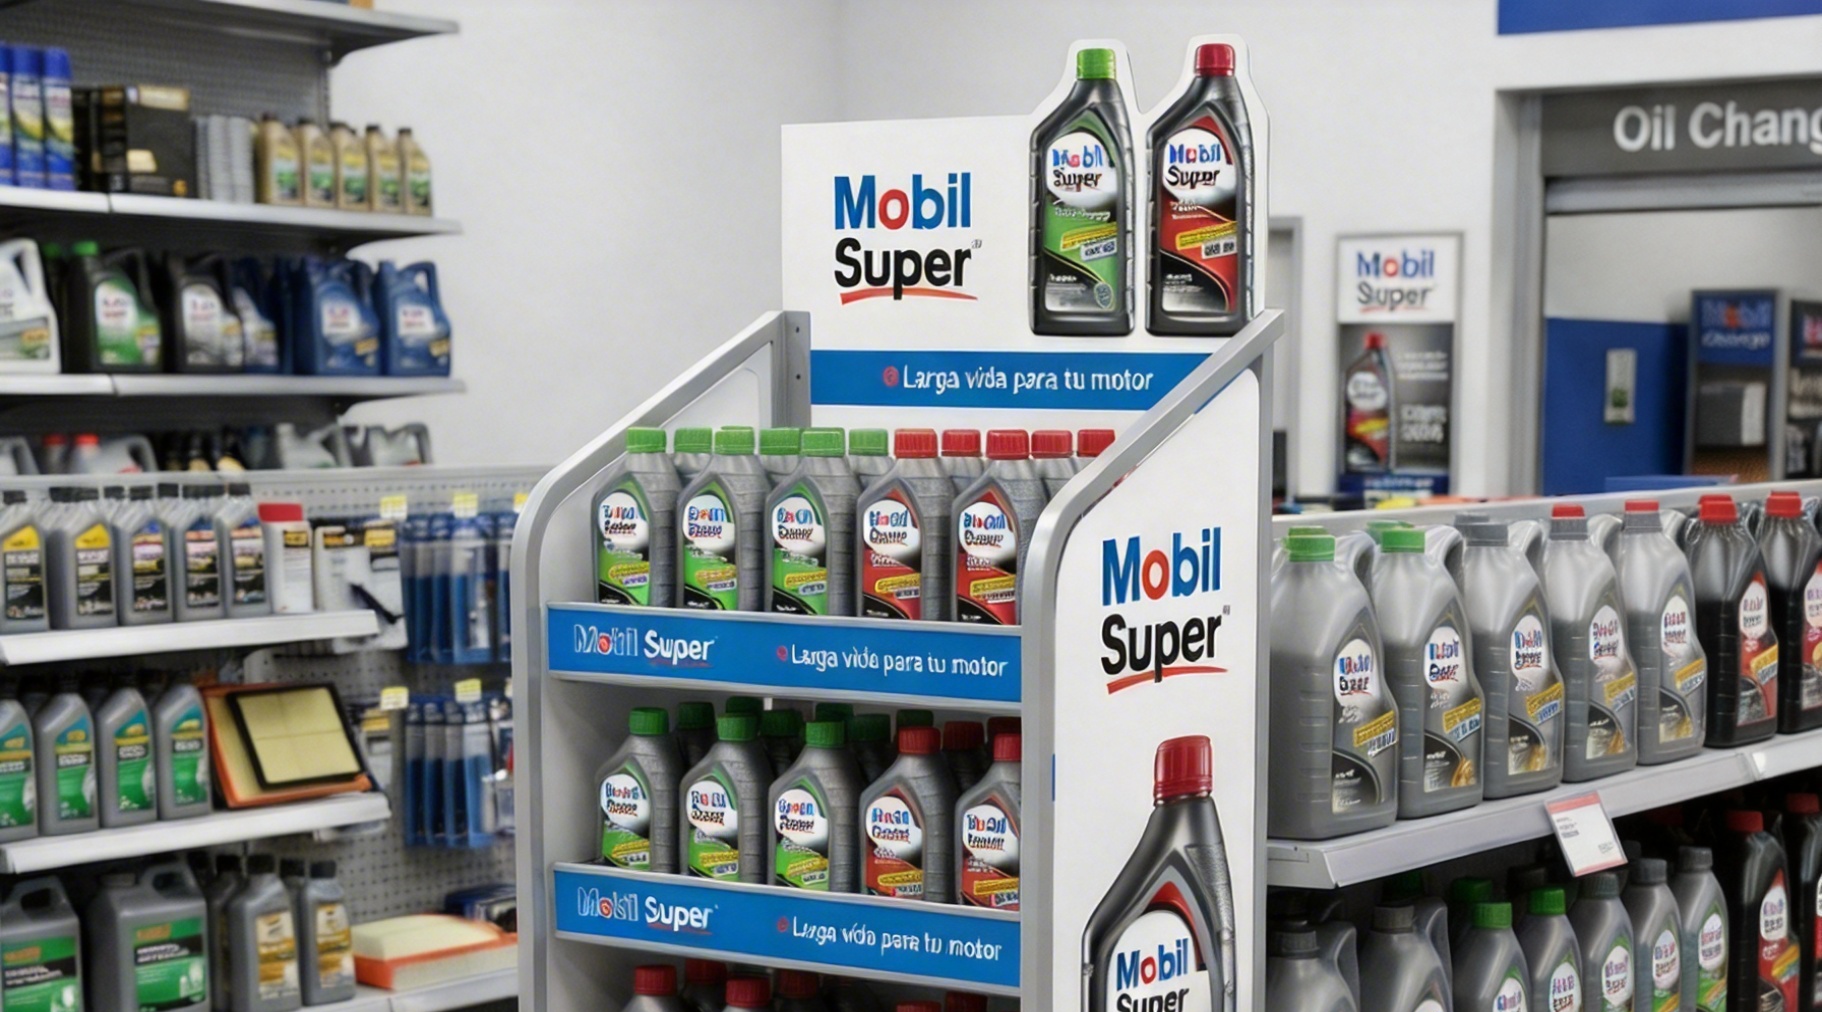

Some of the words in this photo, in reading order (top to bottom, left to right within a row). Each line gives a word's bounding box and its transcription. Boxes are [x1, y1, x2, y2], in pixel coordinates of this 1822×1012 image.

[1613, 104, 1676, 152] Oil
[834, 172, 971, 231] Mobil
[834, 237, 972, 301] Super
[1357, 250, 1434, 278] Mobil
[1357, 281, 1432, 311] Super
[903, 364, 960, 395] Larga
[964, 366, 1007, 389] vida
[1013, 372, 1059, 394] para
[1064, 368, 1085, 390] tu
[1091, 368, 1154, 391] motor
[1102, 527, 1221, 606] Mobil
[644, 629, 715, 665] Super
[884, 653, 923, 676] para
[928, 652, 946, 673] tu
[951, 655, 1008, 677] motor
[1101, 612, 1222, 683] Super
[645, 895, 713, 932] Super
[881, 932, 920, 956] para
[924, 931, 942, 954] tu
[946, 937, 1002, 961] motor
[1116, 937, 1189, 991] Mobil
